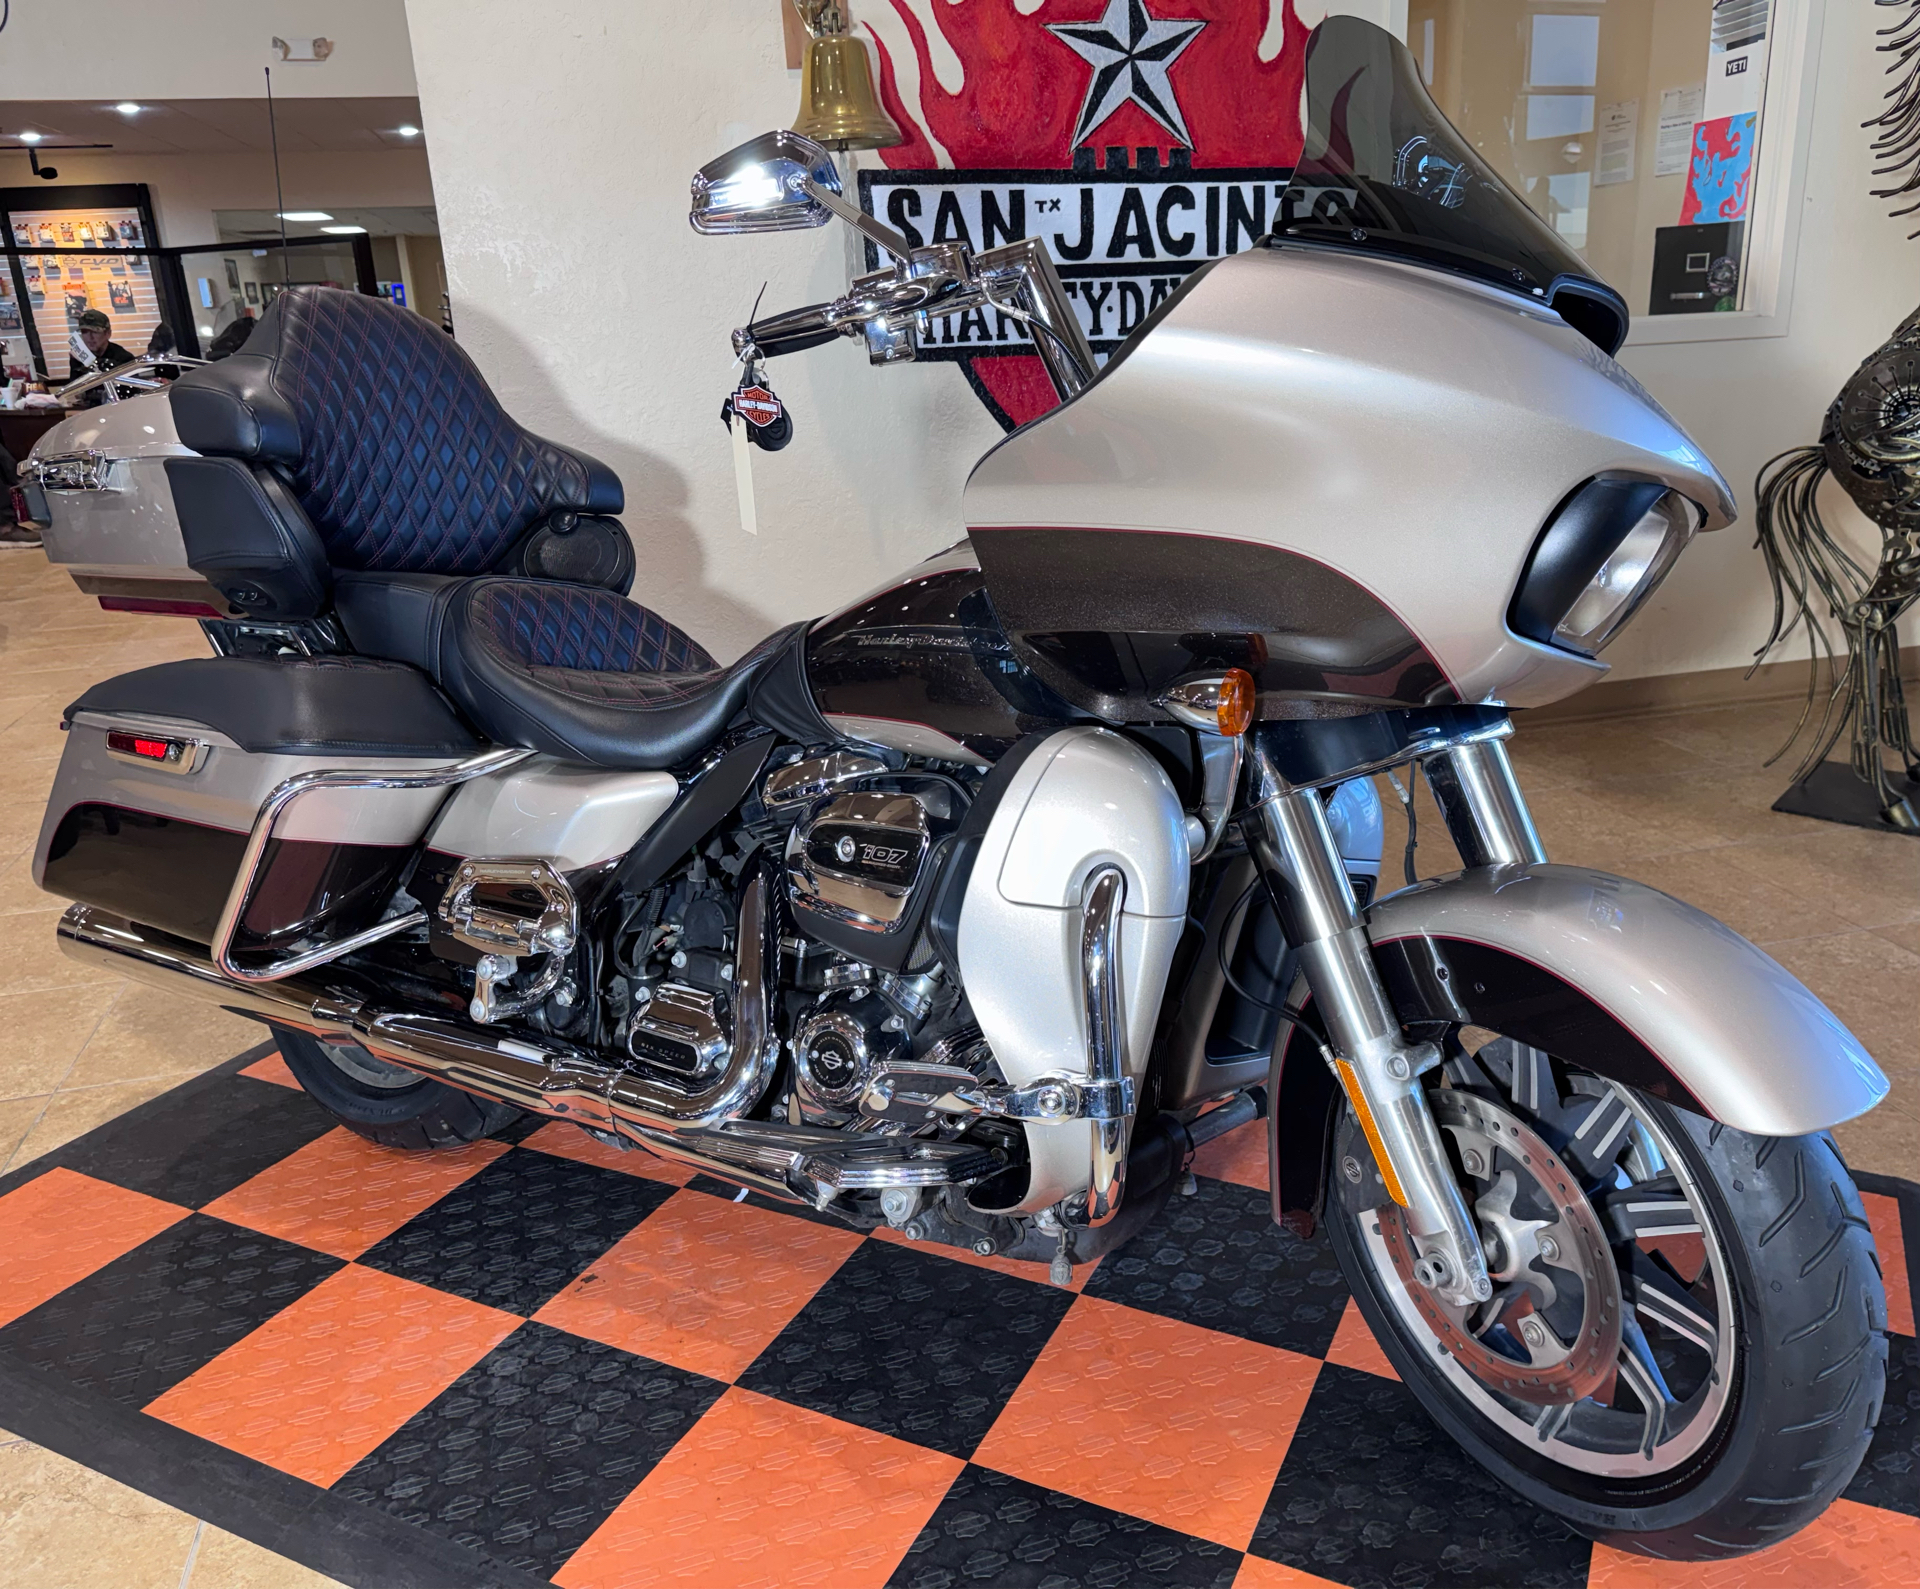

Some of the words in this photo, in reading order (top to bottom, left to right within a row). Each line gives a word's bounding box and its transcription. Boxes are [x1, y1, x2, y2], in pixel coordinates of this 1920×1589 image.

[1727, 59, 1747, 74] YETI
[887, 188, 1026, 263] SAN
[1034, 198, 1061, 213] TX
[79, 257, 119, 266] CVO
[747, 391, 769, 400] MOTOR
[749, 411, 770, 421] CYCLES
[862, 845, 909, 864] 107
